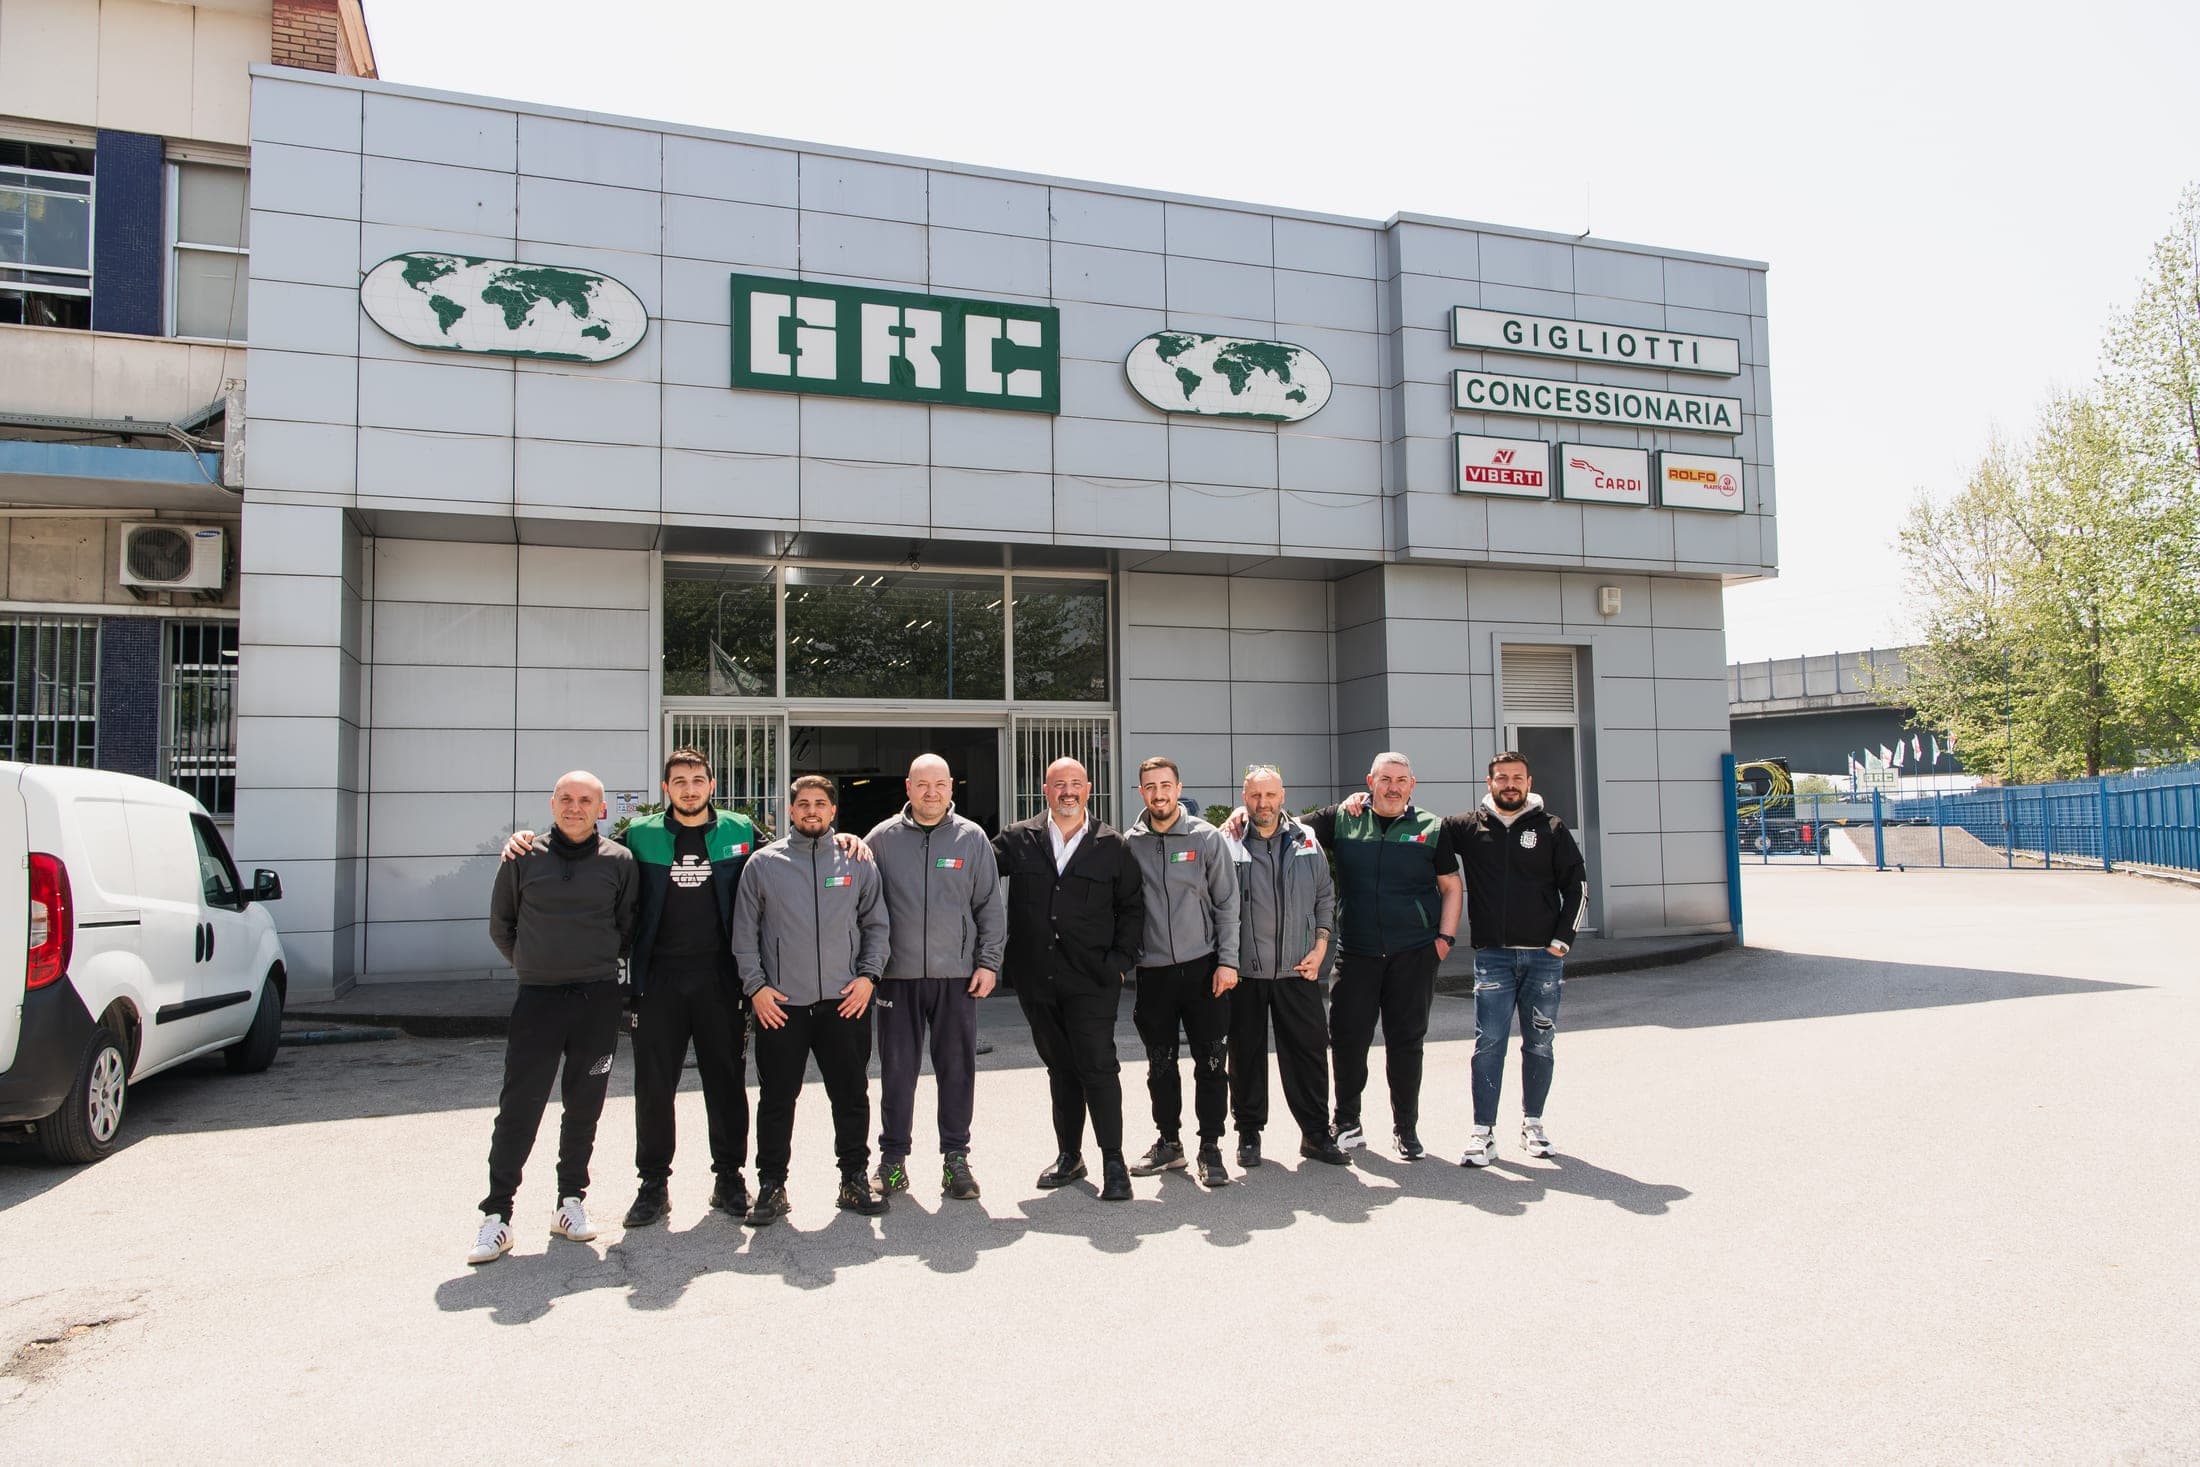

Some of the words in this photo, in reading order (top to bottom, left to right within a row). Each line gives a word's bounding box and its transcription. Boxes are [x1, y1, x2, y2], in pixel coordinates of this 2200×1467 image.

[750, 291, 1042, 398] GRC
[1502, 320, 1699, 364] GIGLIOTTI
[1466, 378, 1732, 427] CONCESSIONARIA
[1468, 467, 1541, 485] VIBERTI
[1595, 477, 1641, 491] CARDI
[1669, 469, 1716, 482] ROLFO
